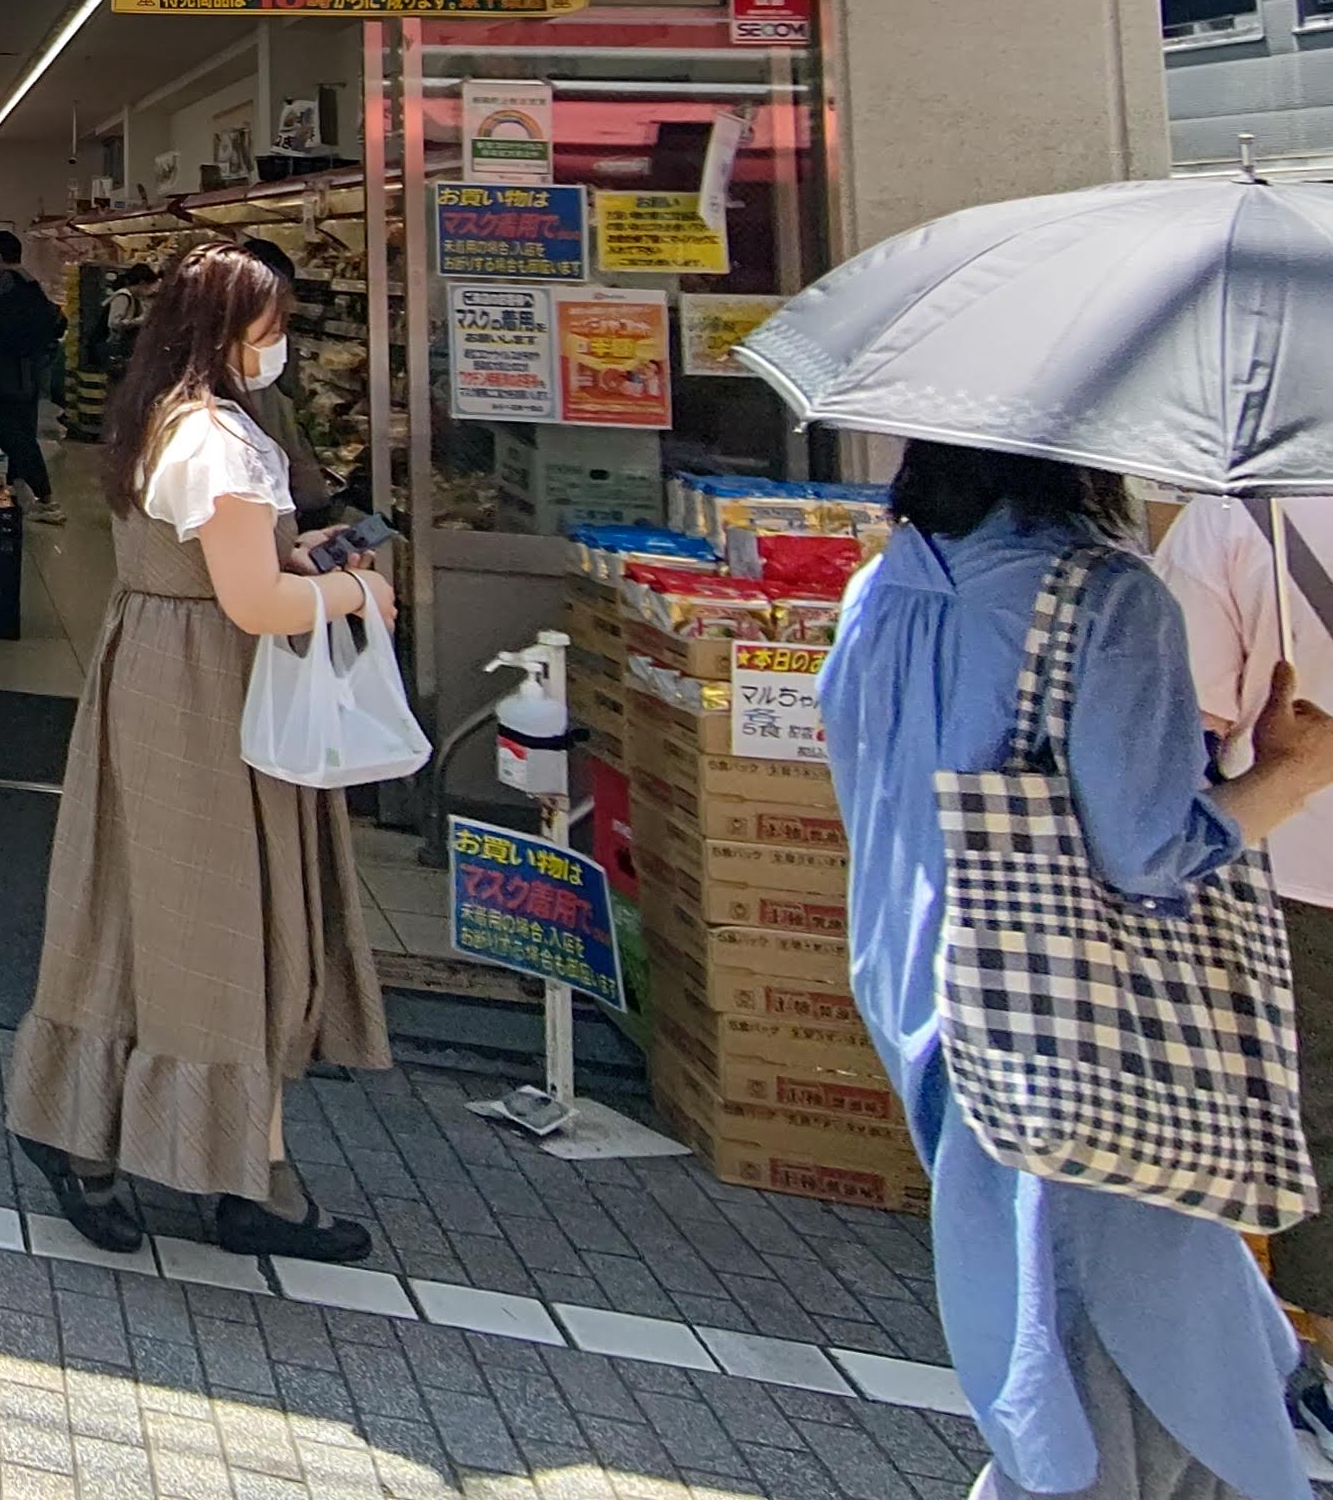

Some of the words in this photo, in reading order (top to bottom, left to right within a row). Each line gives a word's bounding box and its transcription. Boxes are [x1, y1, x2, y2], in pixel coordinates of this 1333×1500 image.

[737, 23, 807, 37] SECOM
[438, 188, 550, 208] お買い物は
[453, 829, 583, 886] お買い物は
